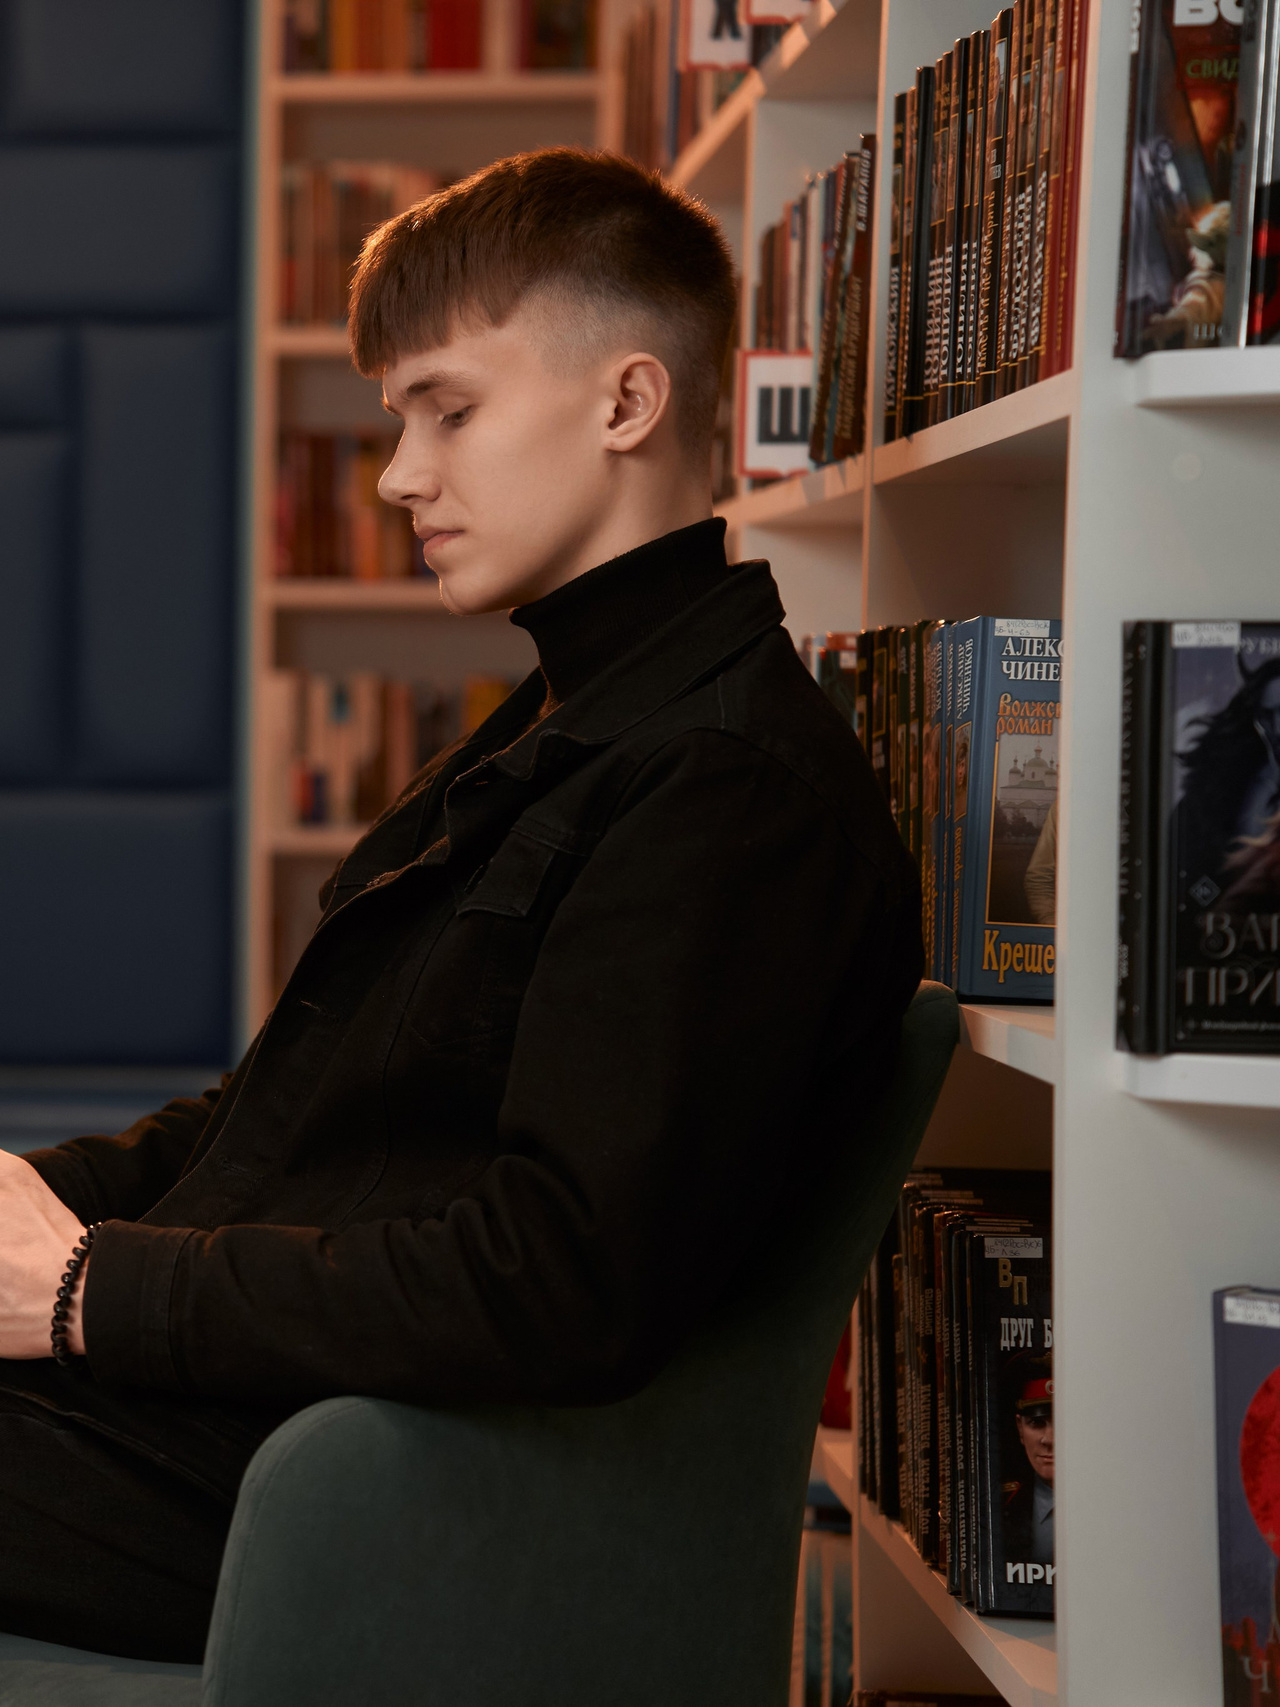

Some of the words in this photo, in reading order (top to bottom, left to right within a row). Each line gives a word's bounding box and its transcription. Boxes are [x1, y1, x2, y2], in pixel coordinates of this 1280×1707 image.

[939, 244, 953, 382] ТОПИЛИН
[955, 241, 969, 379] ТОПИЛИН
[956, 644, 966, 720] АЛЕКСАНДР
[963, 638, 974, 713] ЧИНЕНКОВ
[1001, 661, 1062, 681] ЧИНЕ
[996, 717, 1053, 741] роман
[1000, 1318, 1034, 1351] ДРУГ
[919, 1384, 932, 1448] БАШНЯМИ
[920, 1458, 931, 1497] ТРЕМЯ
